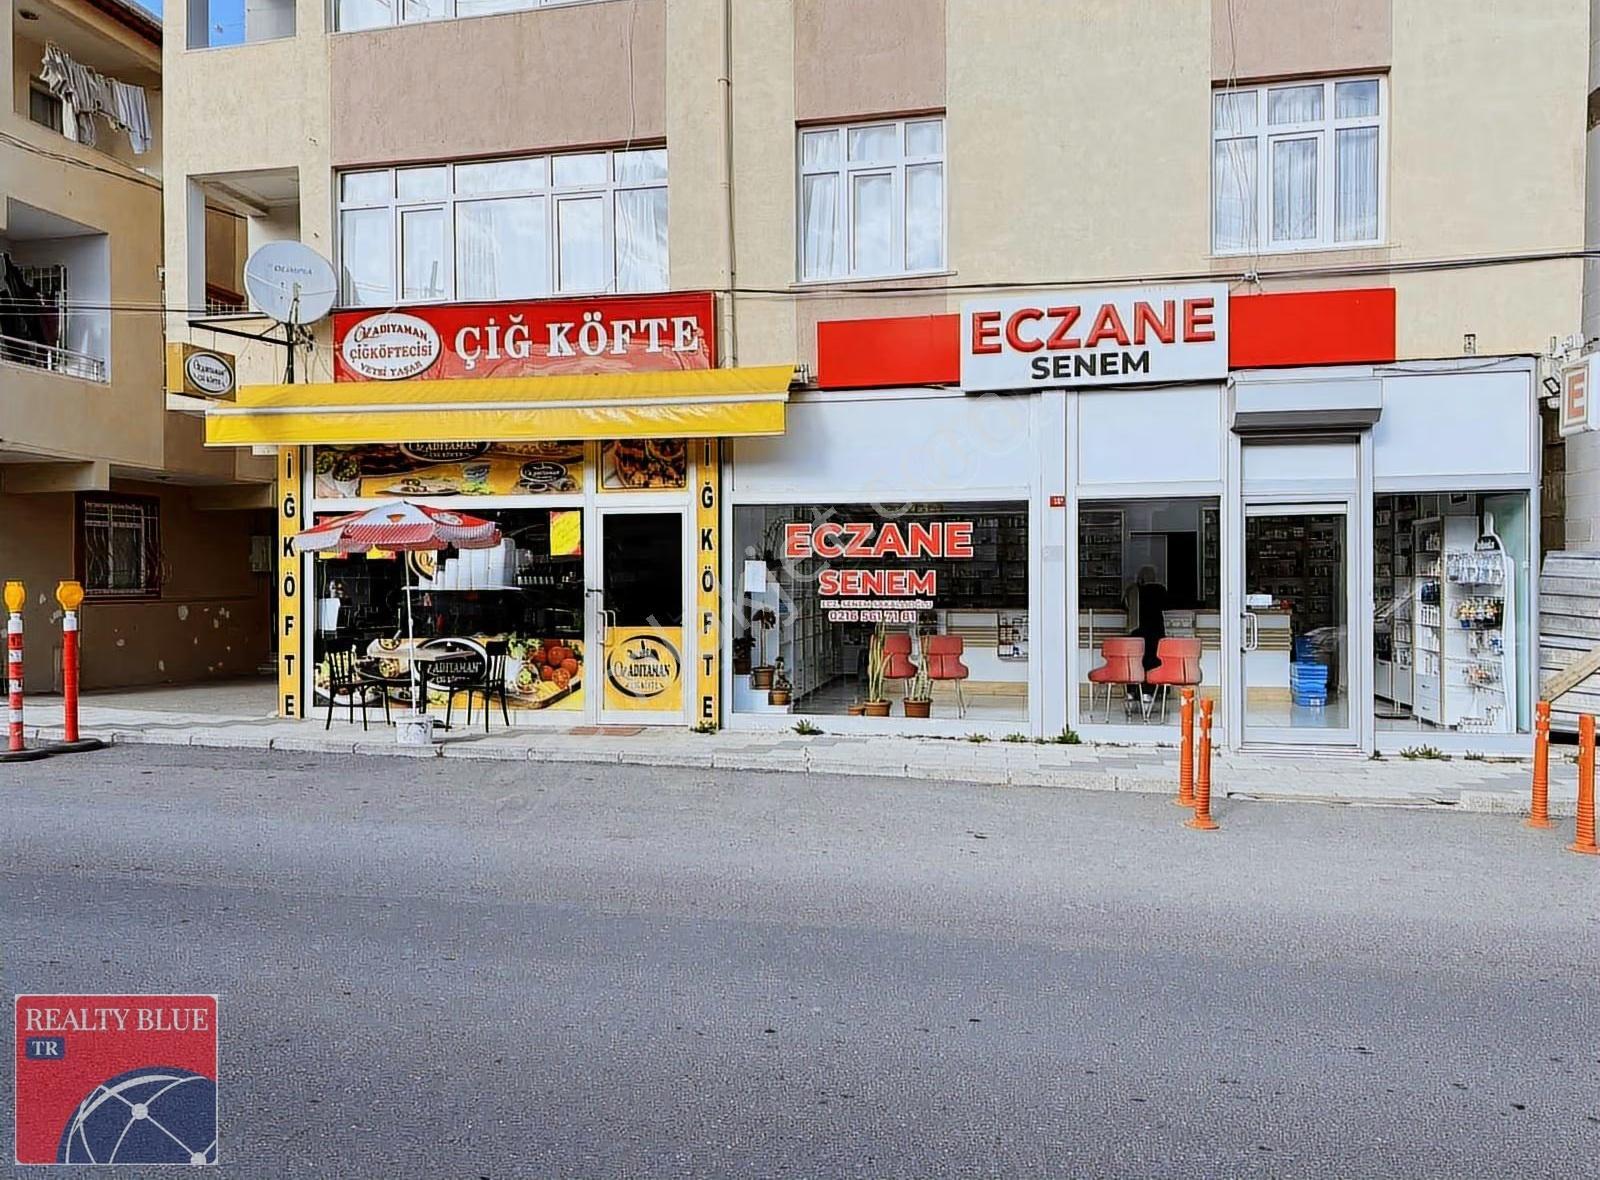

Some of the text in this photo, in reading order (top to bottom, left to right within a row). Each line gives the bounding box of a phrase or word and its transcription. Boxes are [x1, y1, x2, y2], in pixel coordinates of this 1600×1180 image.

[455, 311, 699, 369] ÇİĞ KÖFTE
[972, 298, 1215, 354] ECZANE
[1031, 350, 1150, 380] SENEM
[785, 522, 974, 558] ECZANE
[818, 570, 936, 596] SENEM
